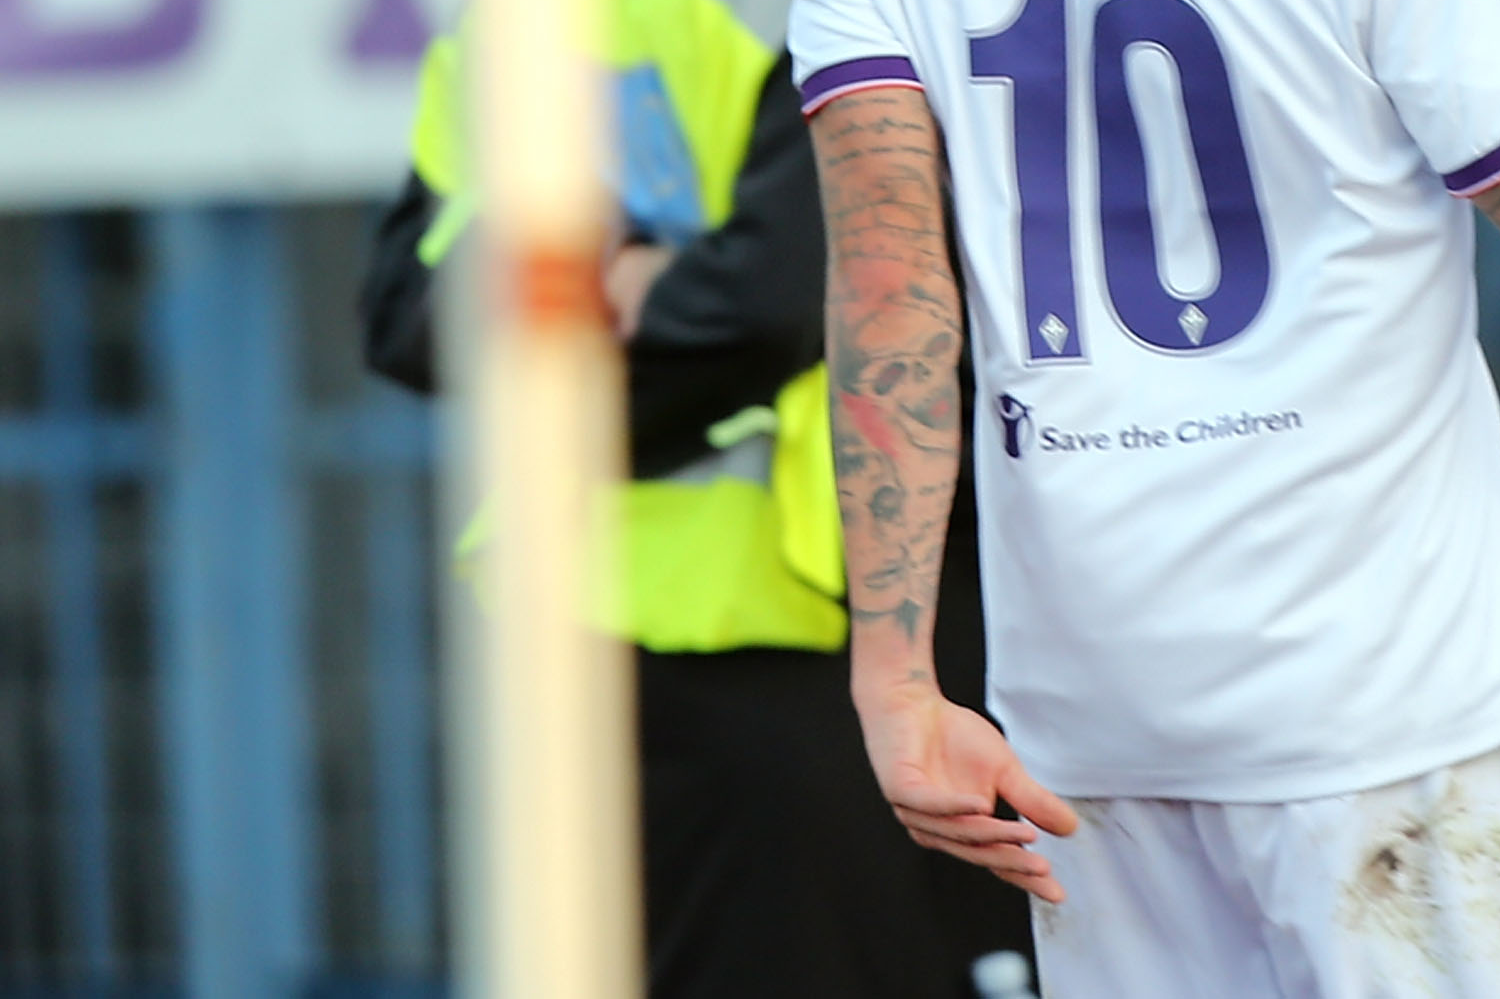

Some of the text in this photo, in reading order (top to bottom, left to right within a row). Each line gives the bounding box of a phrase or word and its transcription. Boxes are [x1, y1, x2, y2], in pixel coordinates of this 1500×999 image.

[1039, 409, 1303, 452] Save the Children
